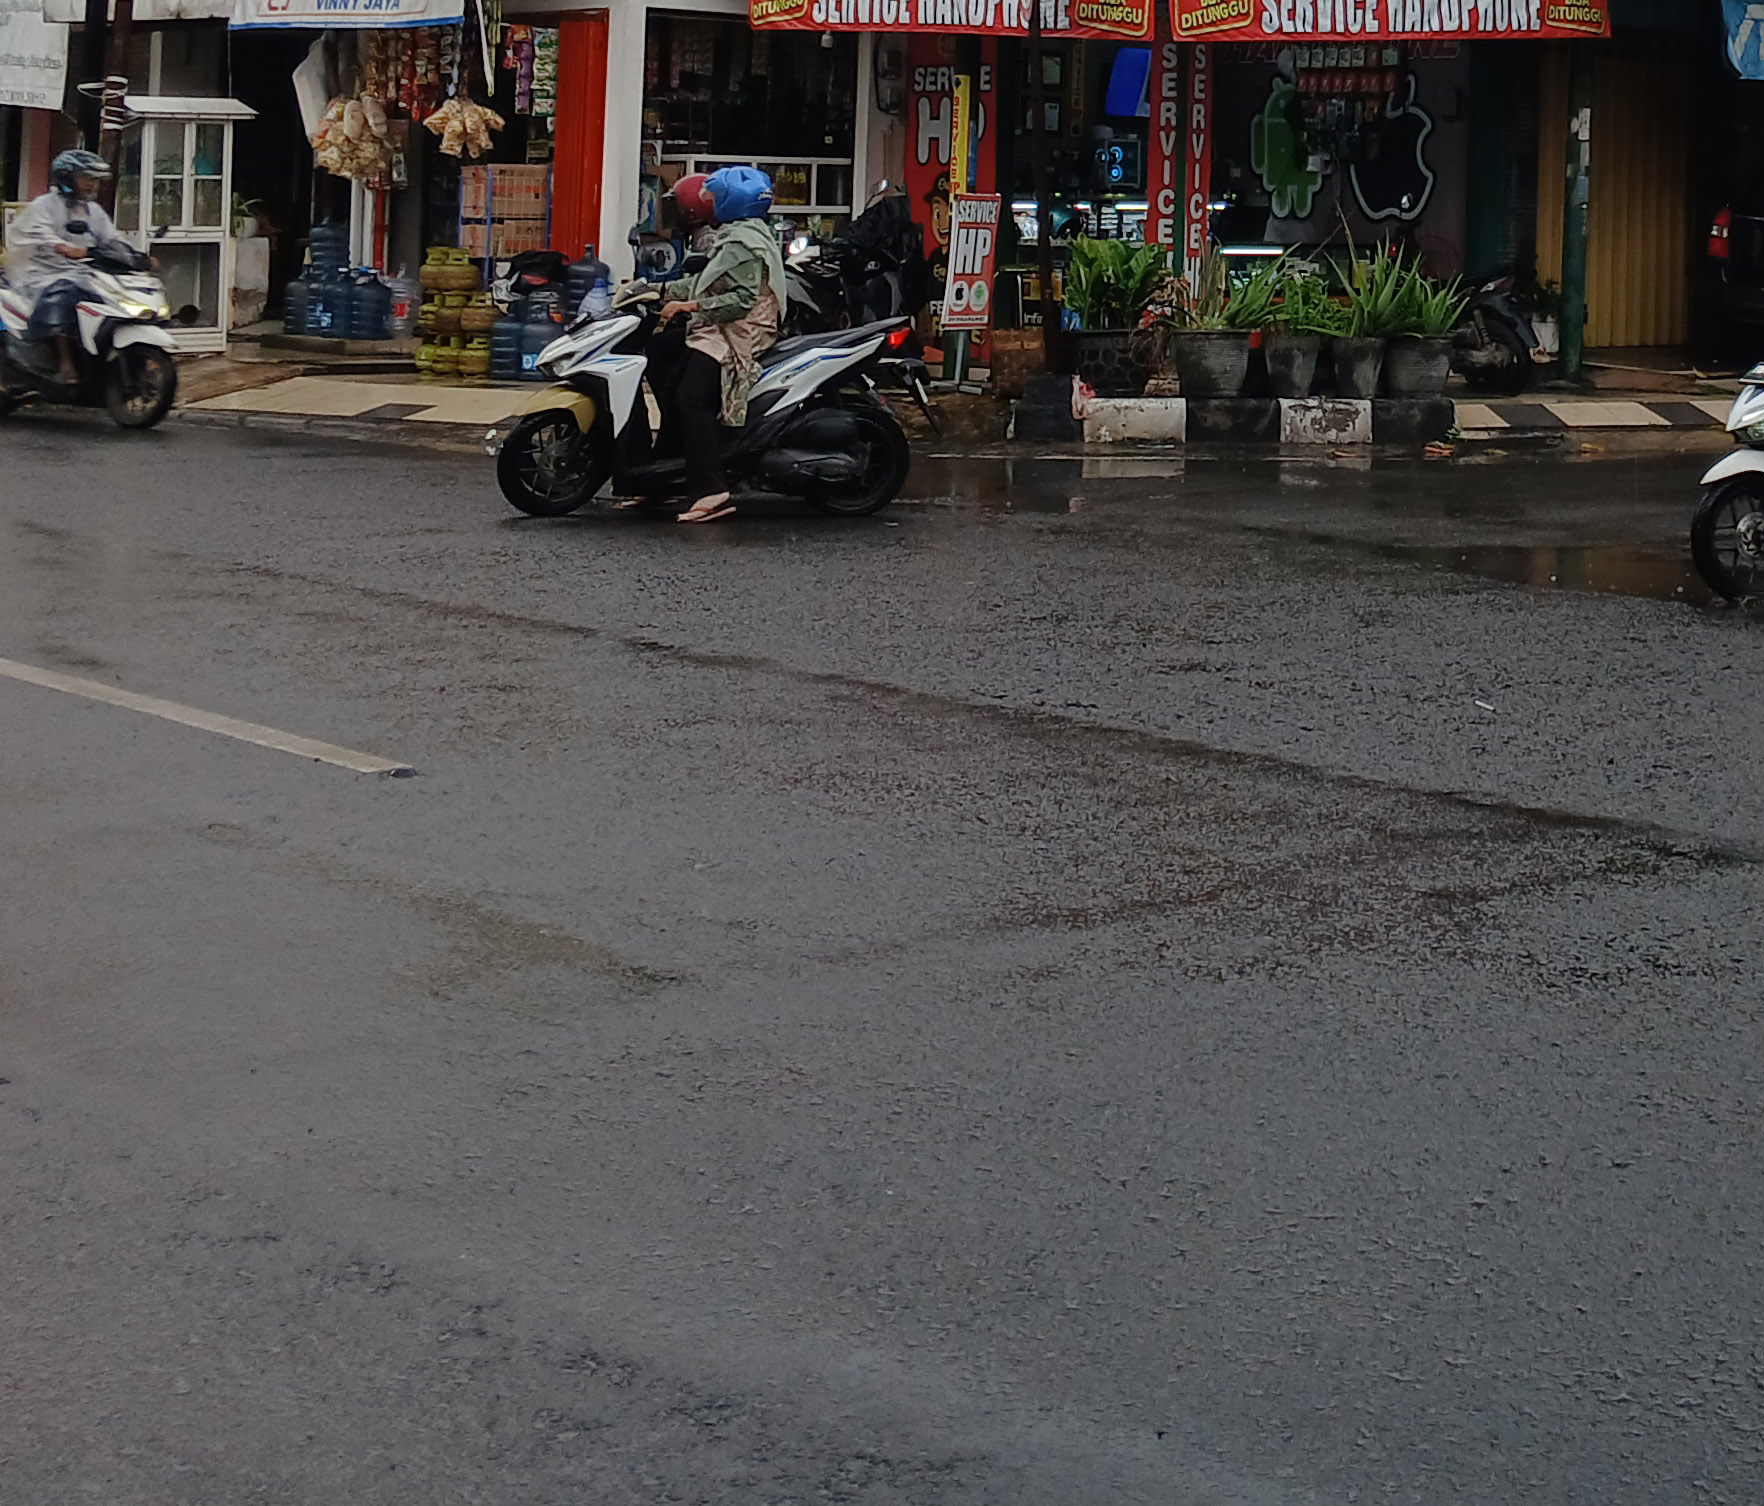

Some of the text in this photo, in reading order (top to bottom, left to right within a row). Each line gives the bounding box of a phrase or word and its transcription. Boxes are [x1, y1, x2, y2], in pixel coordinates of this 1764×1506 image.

[812, 0, 910, 24] SERVICE
[1079, 3, 1142, 24] DITUNGGU
[1181, 1, 1249, 29] DITUNGGU
[1261, 0, 1541, 34] SERVICE HANDPHONE
[914, 65, 991, 92] SERE
[1157, 42, 1178, 244] SERVICE
[957, 199, 999, 224] SERVICE
[954, 227, 992, 275] HP
